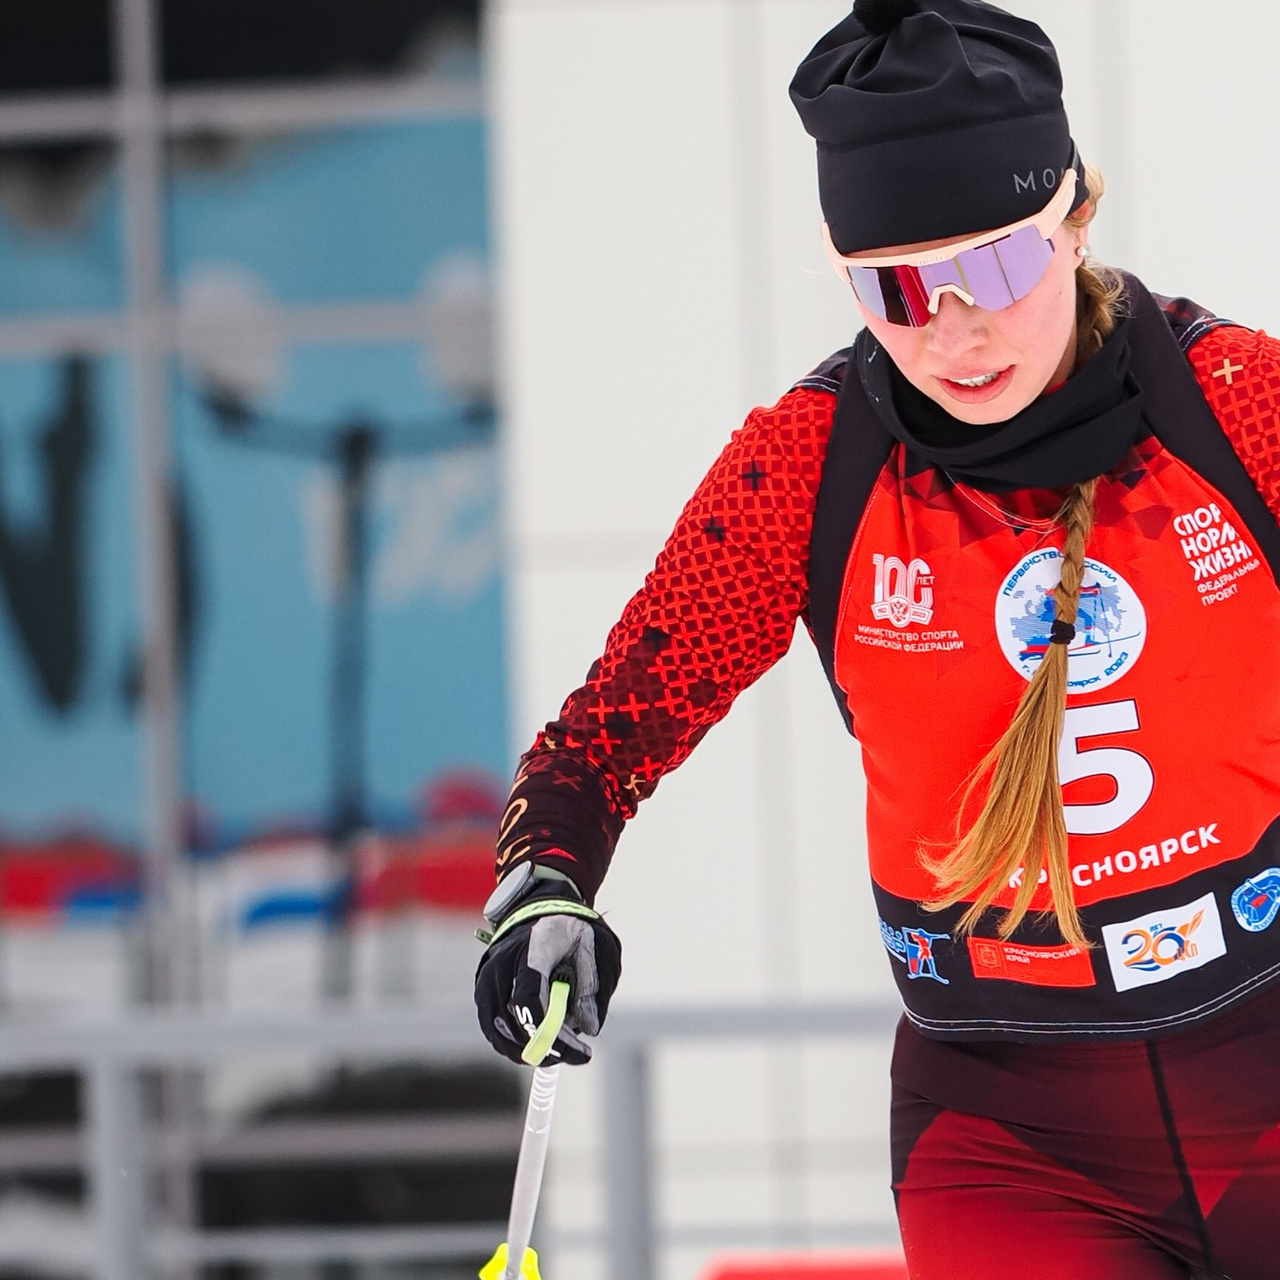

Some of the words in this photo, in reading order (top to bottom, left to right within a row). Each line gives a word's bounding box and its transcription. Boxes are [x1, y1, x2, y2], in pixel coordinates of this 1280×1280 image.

[1013, 167, 1064, 194] MO
[1173, 503, 1221, 536] СПОР
[1180, 521, 1240, 559] НОРМ
[916, 575, 935, 585] ЛЕТ
[1201, 583, 1239, 606] ПРОЕКТ
[854, 634, 902, 651] РОССИЙСКОЙ
[903, 640, 964, 652] ФЕДЕРАЦИИ
[858, 624, 920, 641] МИНИСТЕРСТВО
[921, 630, 959, 641] СПОРТА
[1104, 651, 1129, 676] 2023
[1058, 699, 1155, 835] 5
[1008, 823, 1221, 889] КСНОЯРСК
